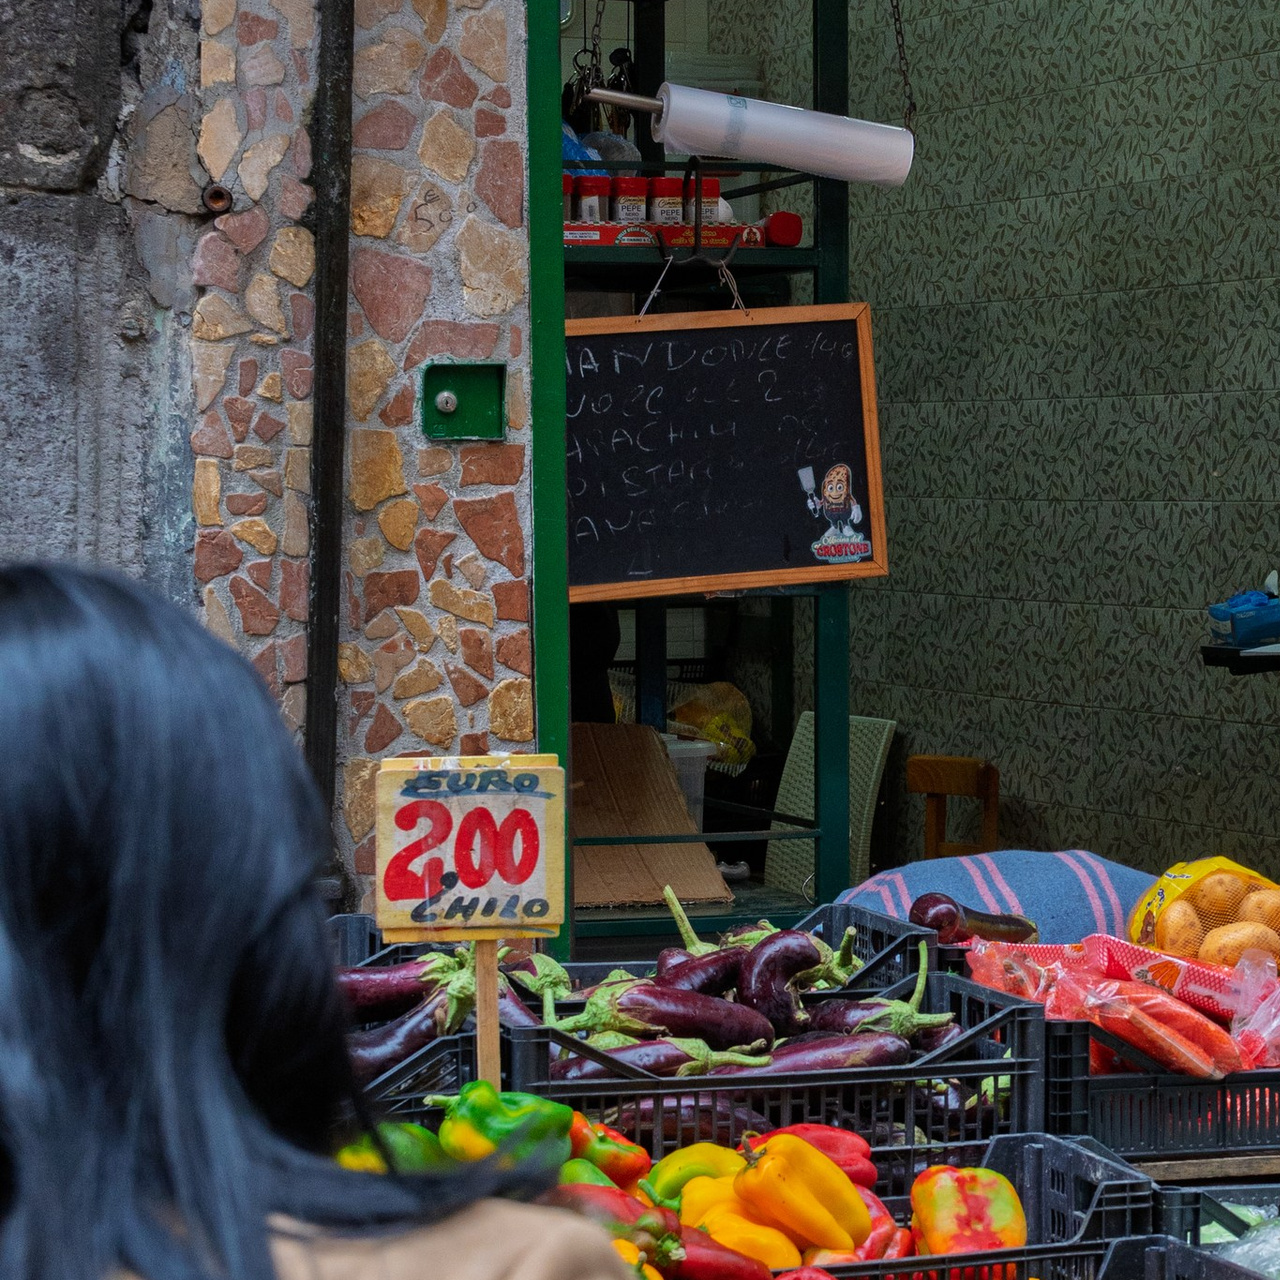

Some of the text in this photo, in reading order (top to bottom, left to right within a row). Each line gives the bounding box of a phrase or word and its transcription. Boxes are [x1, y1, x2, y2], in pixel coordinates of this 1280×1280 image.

[817, 543, 869, 557] CROSTONE
[405, 770, 540, 794] EURO
[410, 893, 550, 923] CHILO
